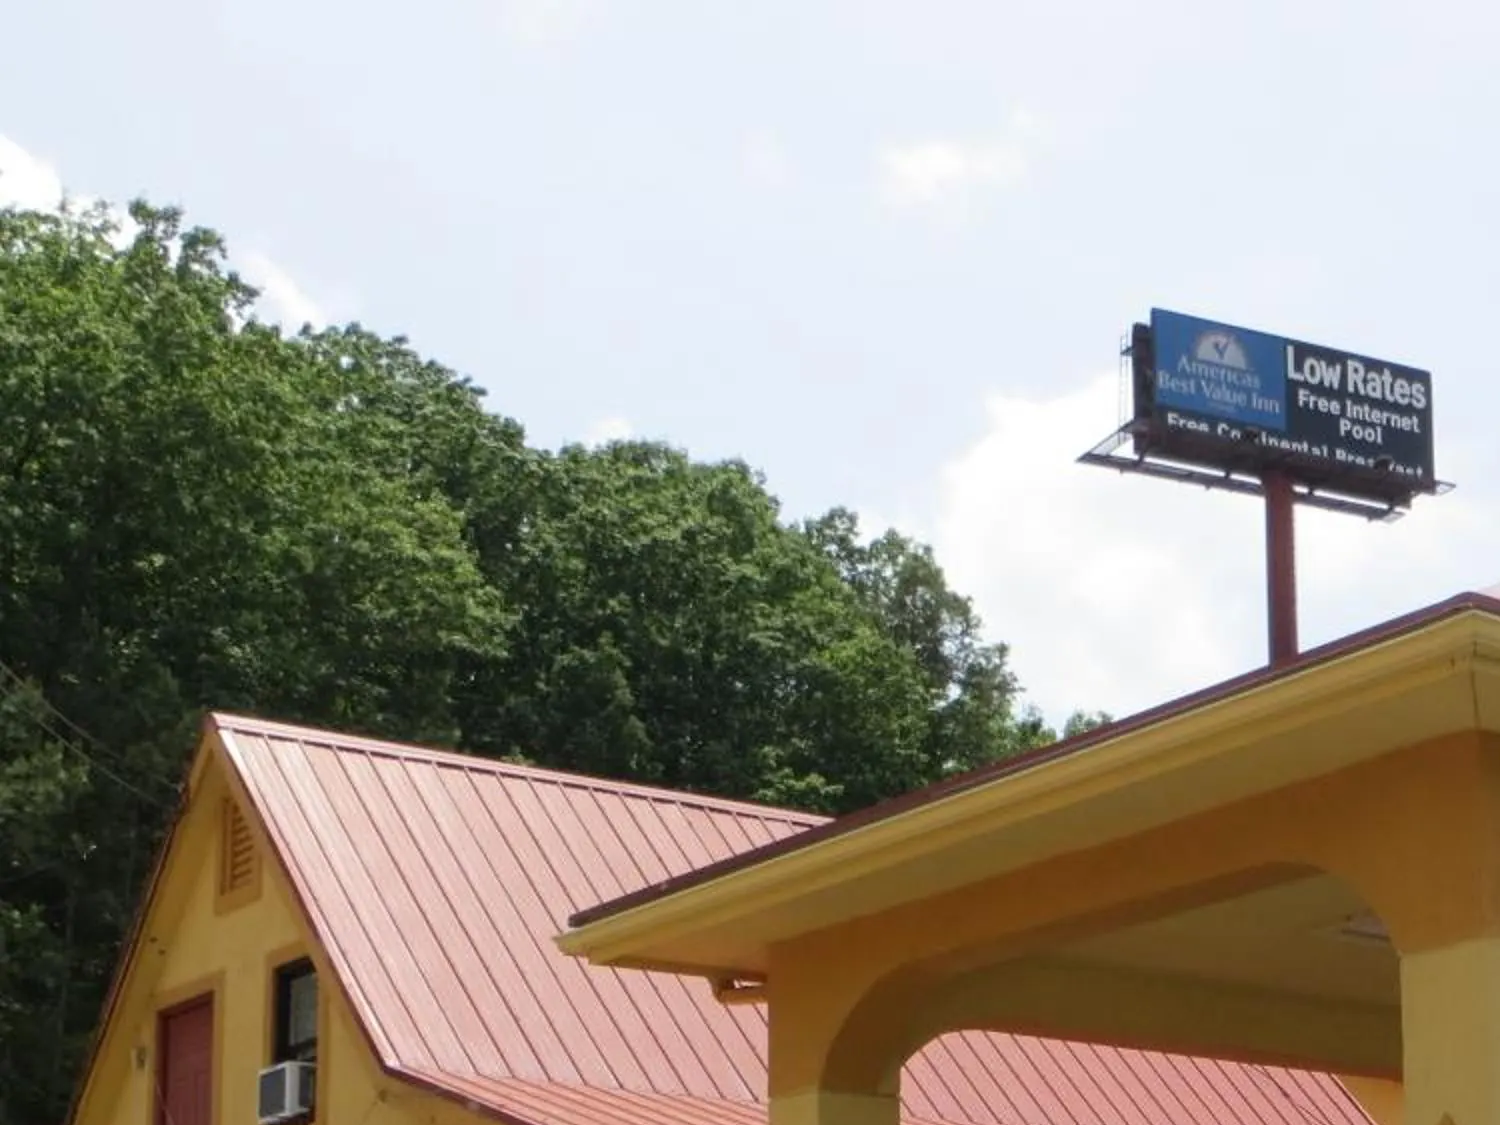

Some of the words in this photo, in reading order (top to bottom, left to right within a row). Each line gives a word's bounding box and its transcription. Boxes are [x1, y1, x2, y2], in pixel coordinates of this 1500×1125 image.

[1159, 370, 1195, 395] Best
[1201, 380, 1247, 407] Value
[1251, 392, 1280, 414] Inn
[1286, 345, 1341, 390] Low
[1347, 359, 1427, 409] Rates
[1298, 387, 1341, 415] Free
[1345, 399, 1421, 433] Internet
[1340, 416, 1383, 444] Pool
